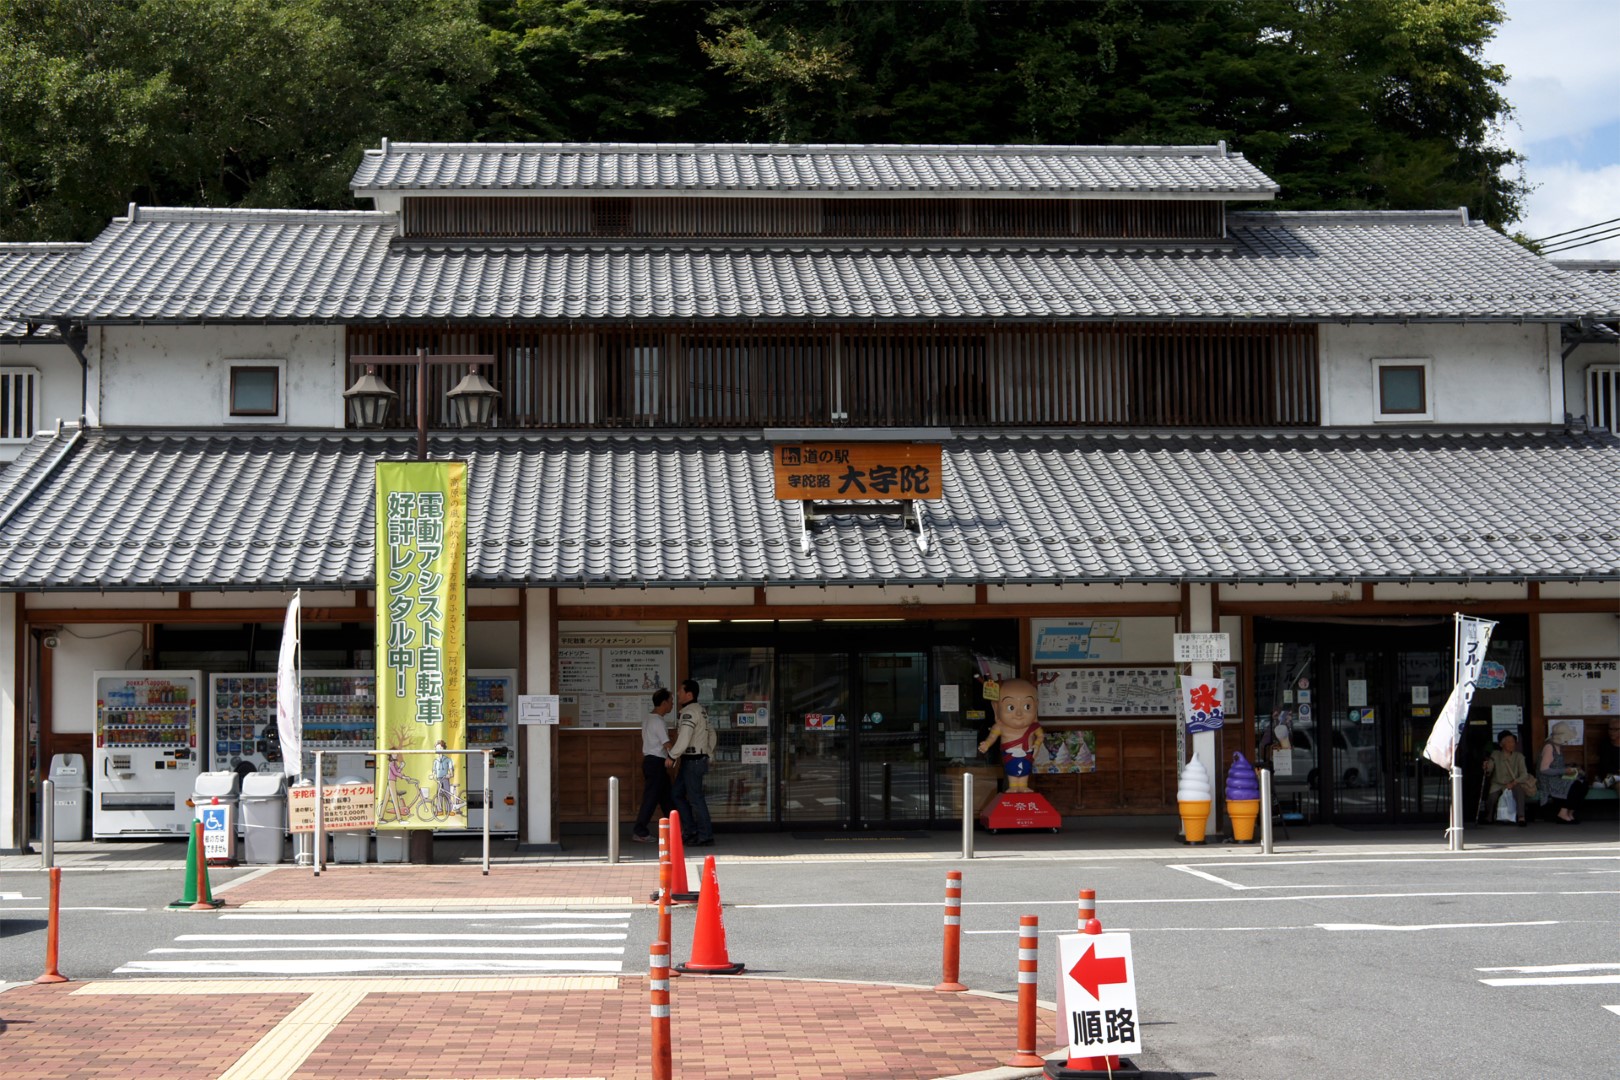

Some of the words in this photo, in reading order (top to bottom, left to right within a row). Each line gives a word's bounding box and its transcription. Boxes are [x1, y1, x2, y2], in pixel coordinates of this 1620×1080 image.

[803, 449, 849, 464] 道の駅
[787, 474, 831, 488] 宇陀路
[838, 464, 930, 494] 大宇陀
[388, 492, 415, 697] 好評レンタル中！
[416, 492, 443, 725] 電動アシスト自転車
[1544, 662, 1566, 671] 道の駅
[1594, 662, 1617, 671] 大宇陀
[1586, 671, 1602, 679] 情報
[1189, 684, 1222, 715] 氷
[293, 786, 375, 799] 宇陀市ンサイクル
[1014, 801, 1039, 811] 奈良
[1072, 1008, 1136, 1046] 順路
